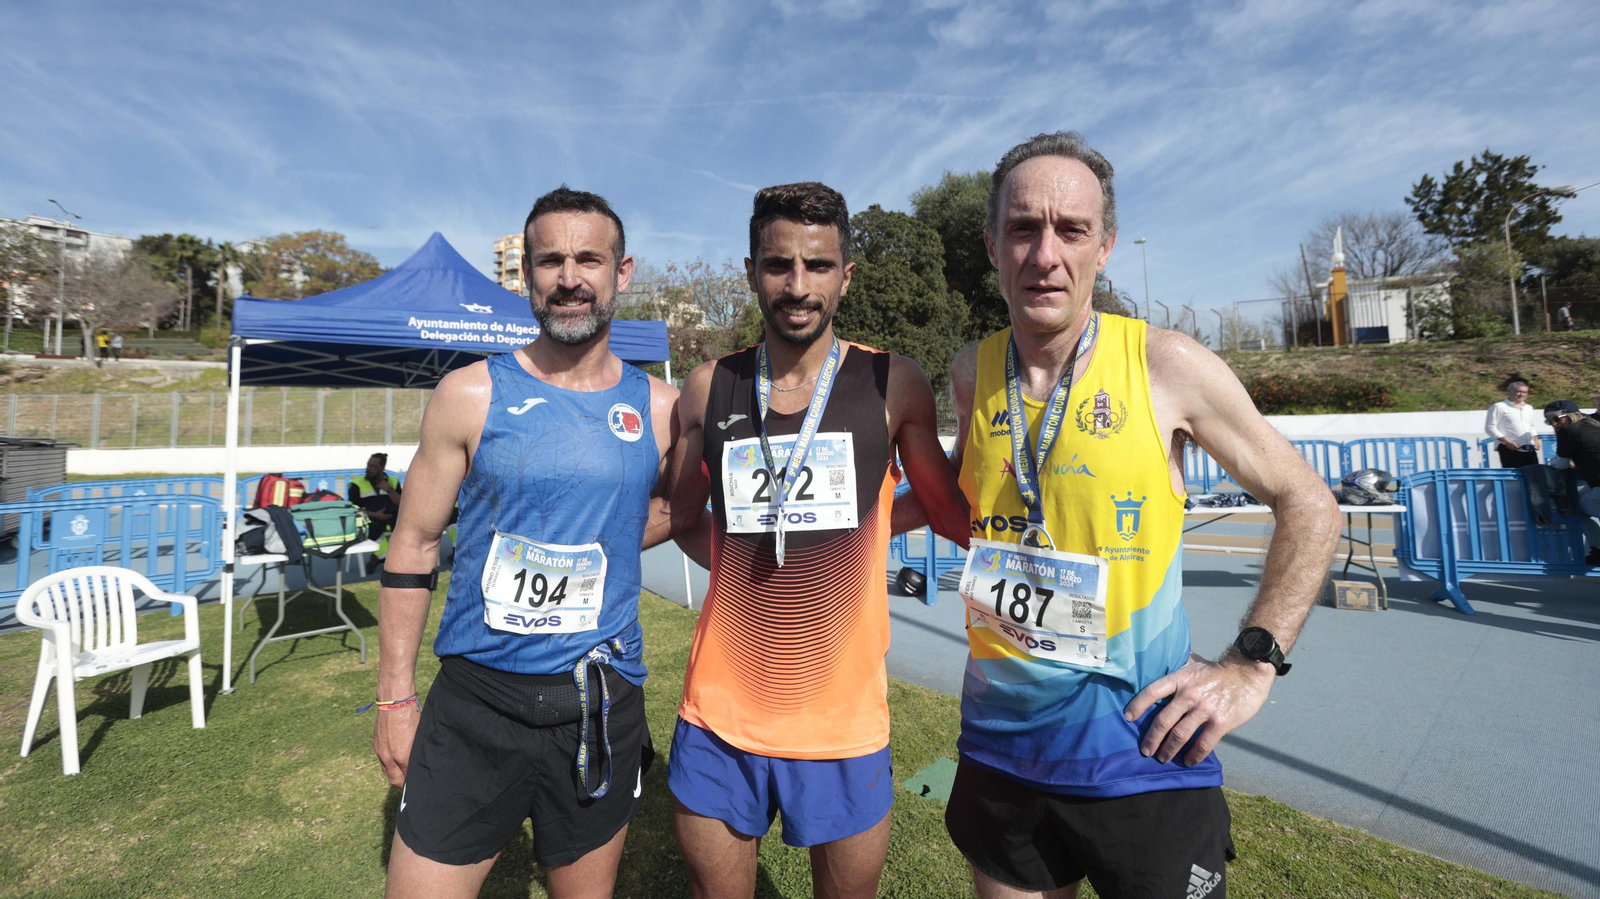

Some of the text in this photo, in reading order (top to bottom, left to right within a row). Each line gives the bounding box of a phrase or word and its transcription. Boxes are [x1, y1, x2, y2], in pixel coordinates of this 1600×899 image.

[408, 316, 541, 335] Ayuntamiento de Algecir
[420, 330, 480, 343] Delegación
[482, 333, 495, 343] de
[821, 357, 836, 388] ALGECIRAS
[819, 387, 827, 396] DE
[810, 395, 824, 417] CIUDAD
[1007, 341, 1031, 484] 9ª MEDIA MARATÓN CIUDAD DE ALGECIRAS
[1041, 414, 1060, 451] MARATÓN
[1052, 387, 1068, 413] CIUDAD
[1061, 375, 1071, 386] DE
[798, 418, 816, 448] MARATÓN
[990, 429, 1011, 438] mobe
[791, 448, 805, 469] MEDIA
[752, 465, 814, 503] 212
[971, 515, 1028, 533] VOS
[526, 551, 574, 568] MARATÓN
[1005, 559, 1055, 578] MARATÓN
[514, 568, 568, 608] 194
[1060, 575, 1082, 583] MARZO
[990, 578, 1055, 628] 187
[1069, 593, 1095, 602] RESULTADOS
[503, 613, 562, 628] EVOS
[1080, 625, 1086, 633] S
[579, 692, 587, 701] DE
[1186, 871, 1222, 899] adidas
